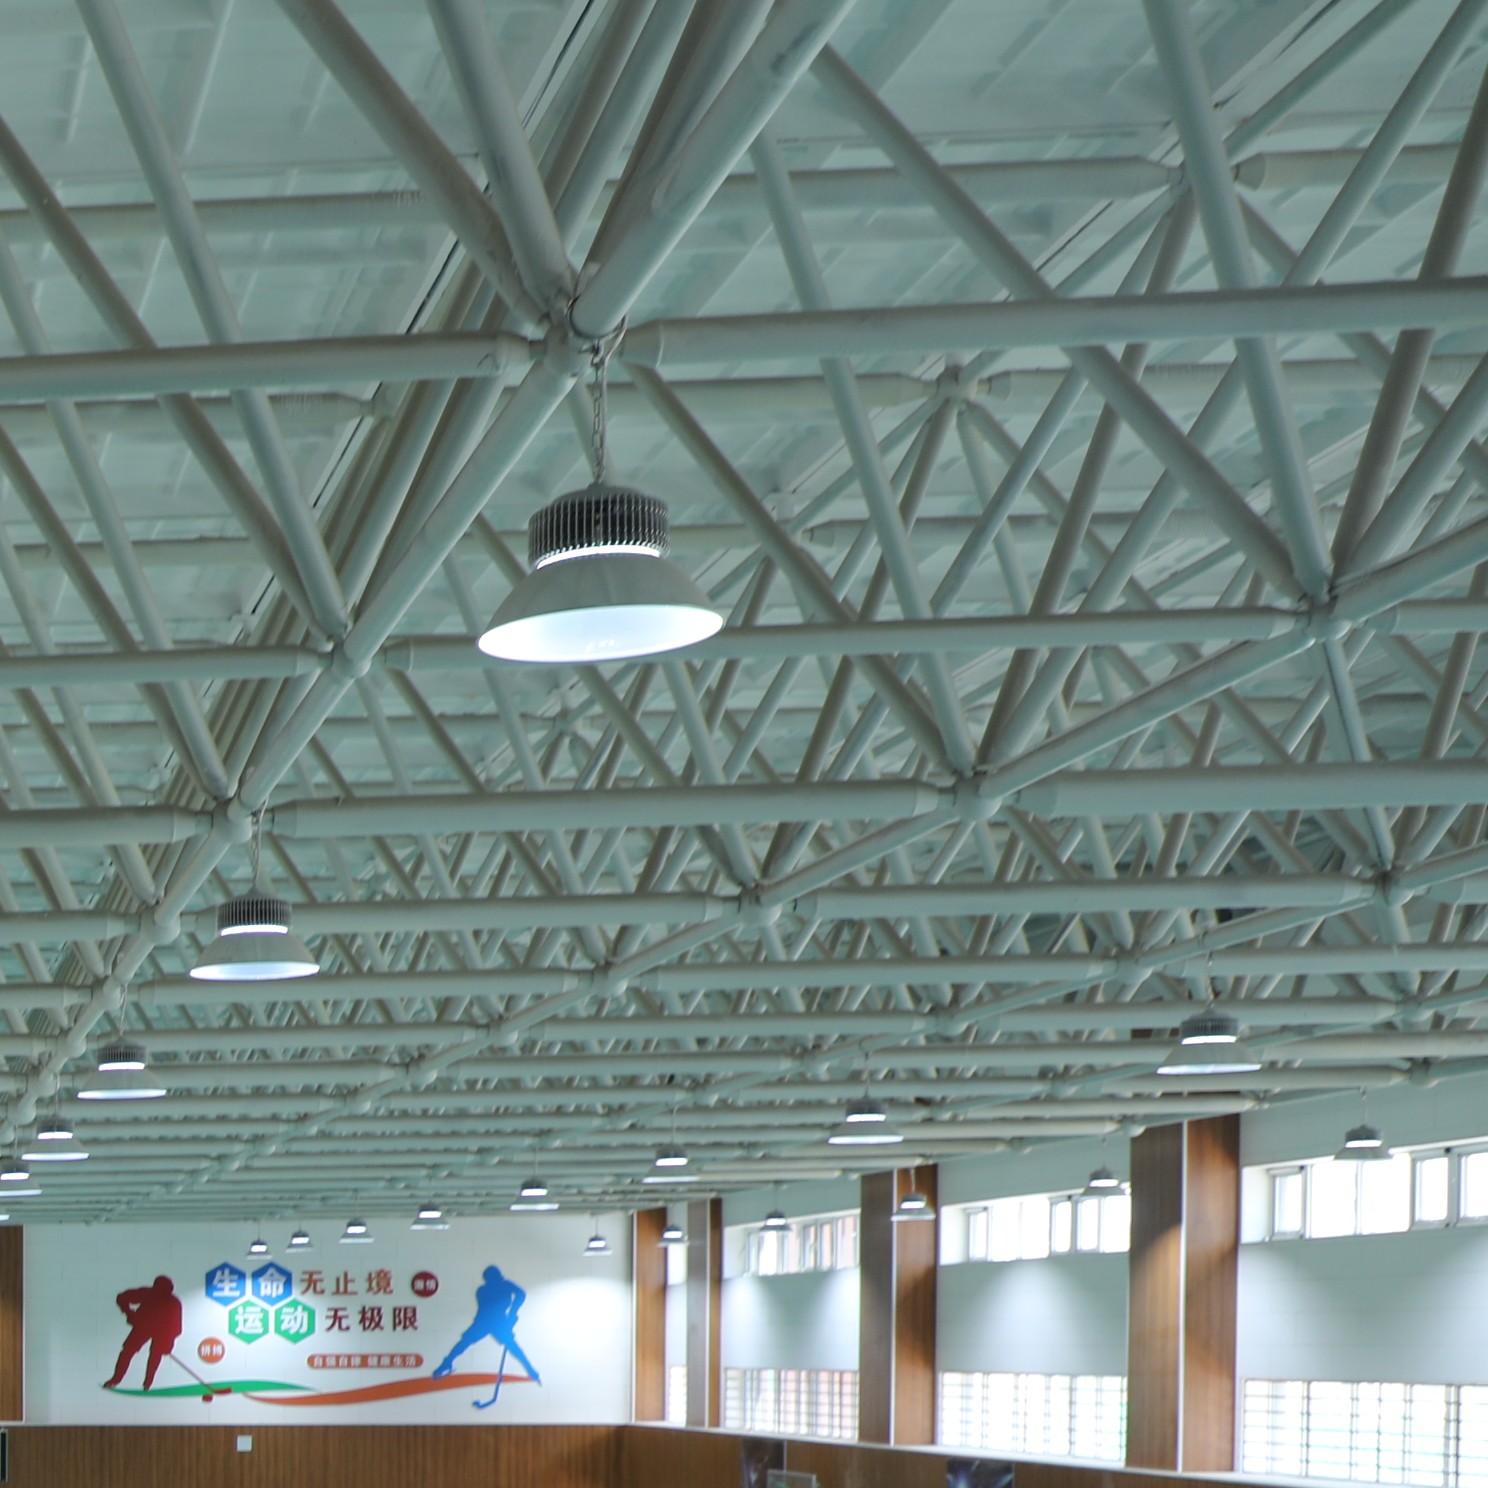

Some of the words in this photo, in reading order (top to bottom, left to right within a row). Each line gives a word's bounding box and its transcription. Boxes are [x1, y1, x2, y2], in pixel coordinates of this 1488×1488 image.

[212, 1267, 394, 1297] 生命无止境
[235, 1305, 419, 1335] 运动无极限
